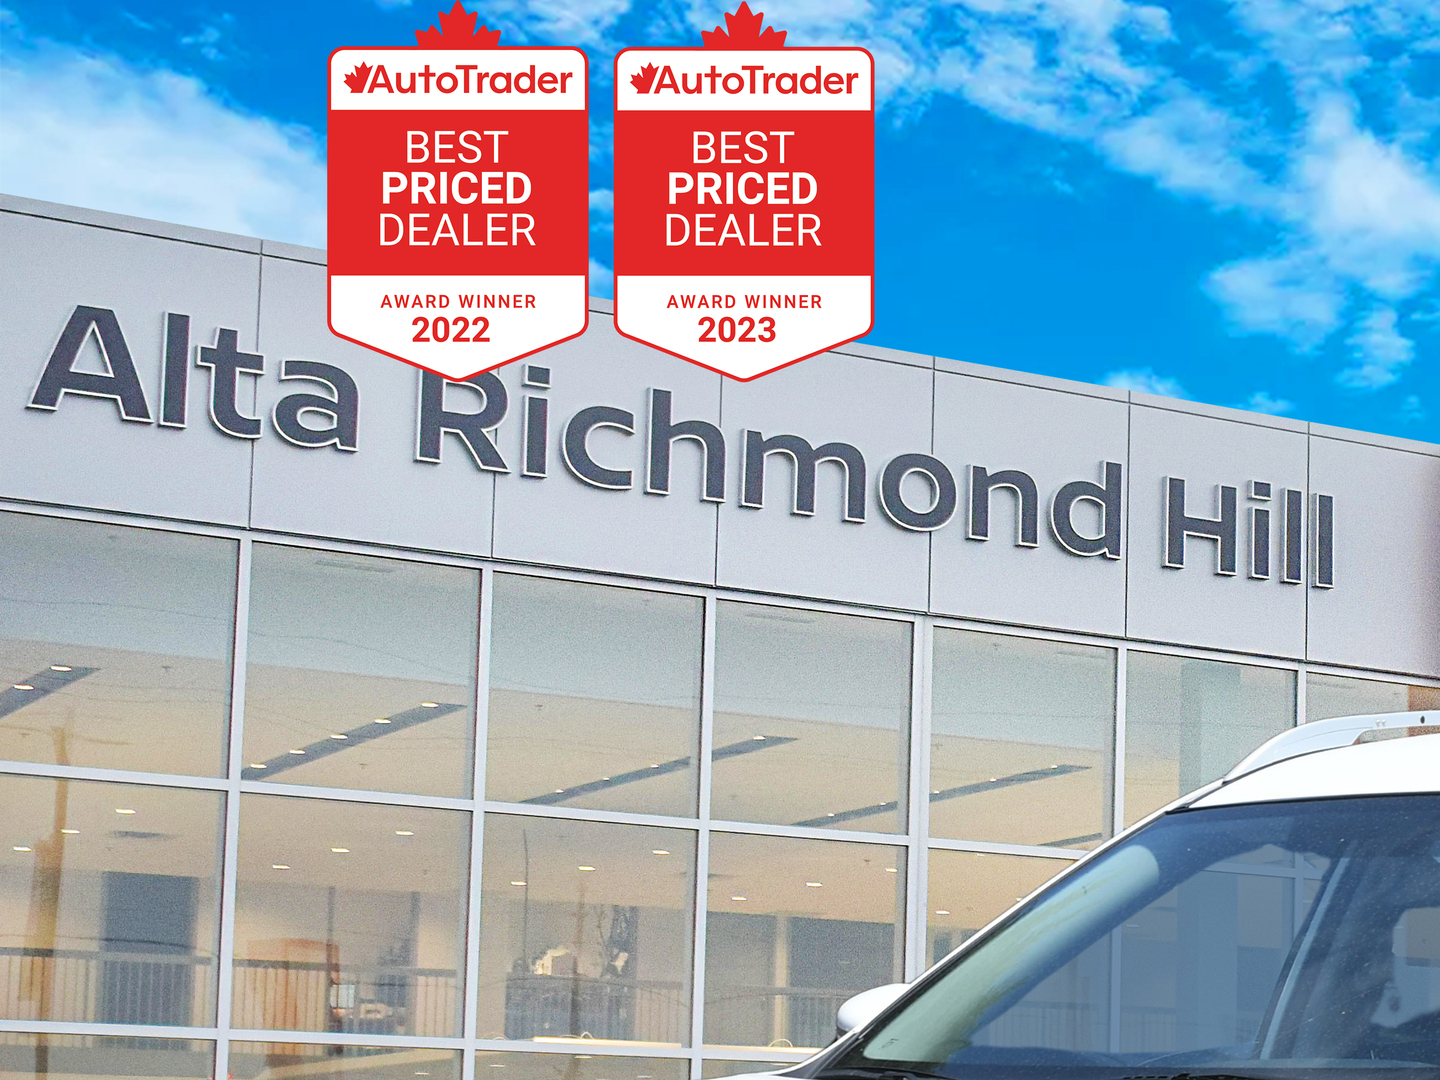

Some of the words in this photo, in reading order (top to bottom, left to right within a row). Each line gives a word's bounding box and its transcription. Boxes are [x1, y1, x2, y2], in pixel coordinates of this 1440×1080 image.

[27, 304, 360, 453] Alta
[414, 365, 1122, 560] Richmond
[1161, 476, 1334, 589] Hill
